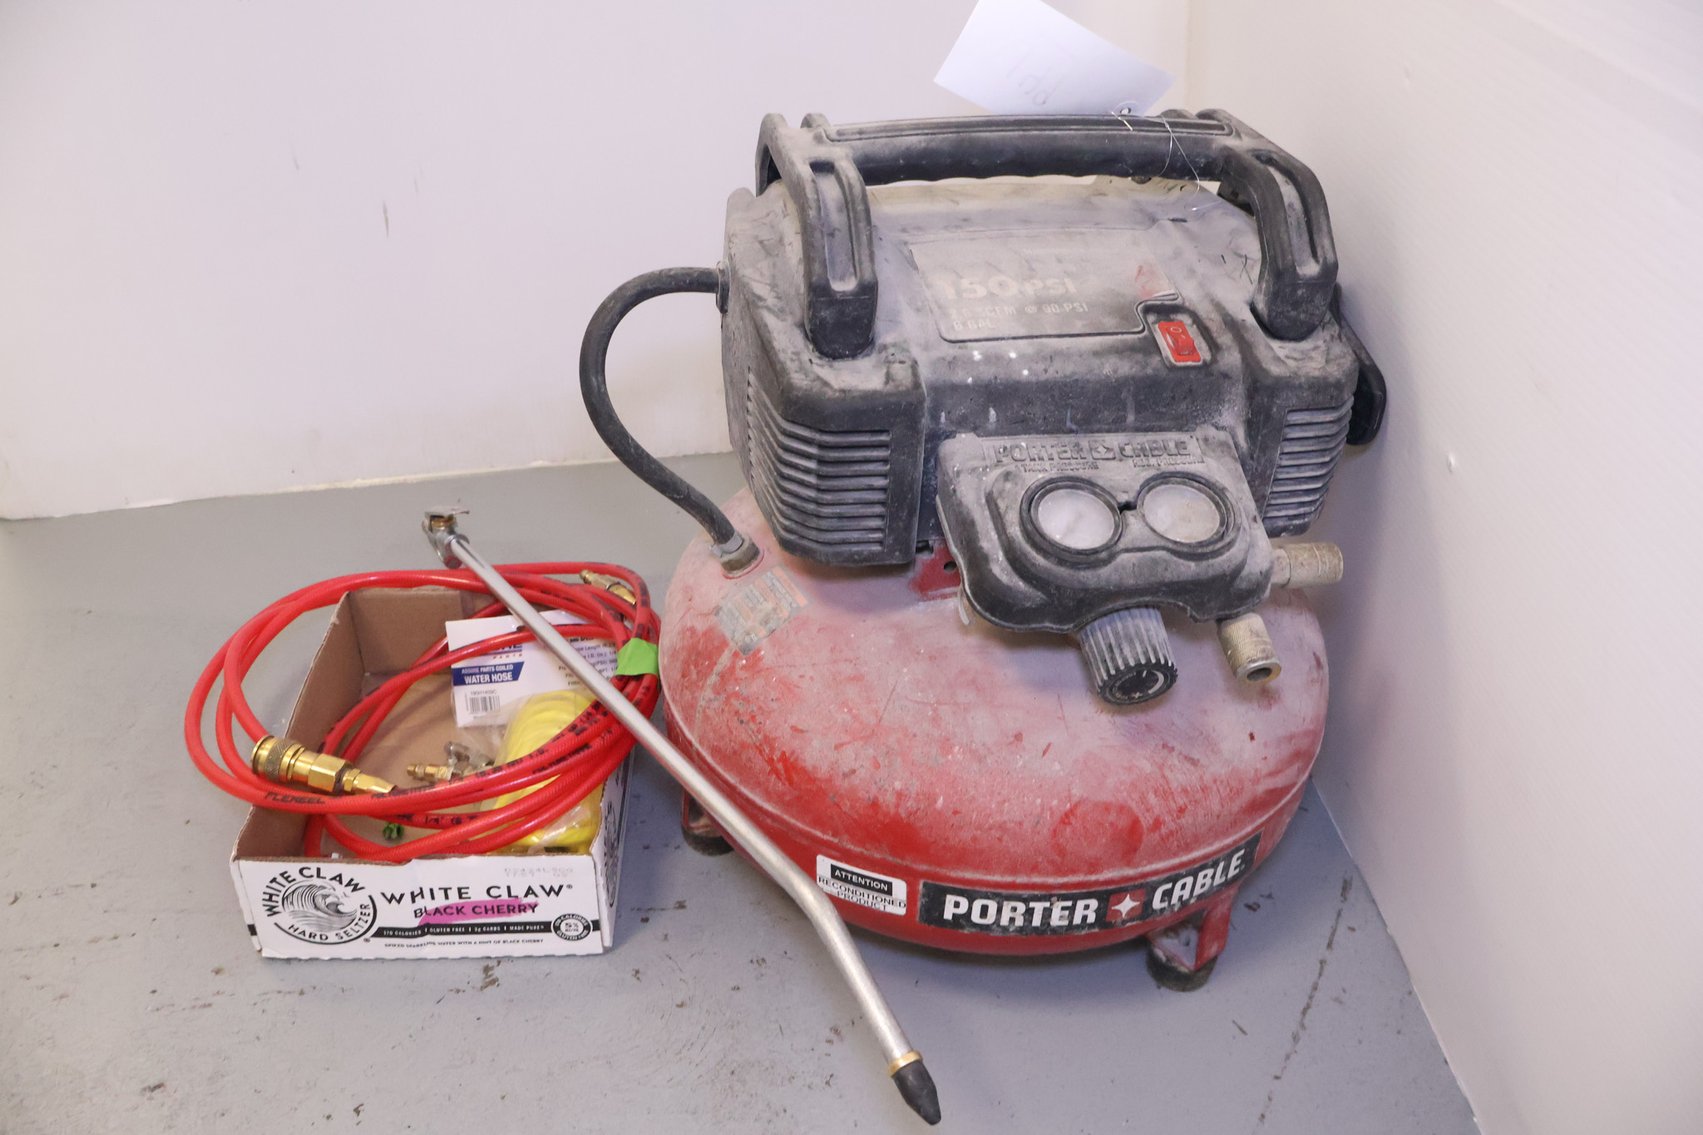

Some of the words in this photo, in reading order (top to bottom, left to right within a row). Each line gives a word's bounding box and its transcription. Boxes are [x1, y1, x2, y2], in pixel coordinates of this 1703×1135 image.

[464, 673, 490, 686] WATER
[491, 671, 513, 683] HOSE
[262, 870, 297, 917] WHITE
[298, 866, 366, 893] CLAW
[818, 875, 907, 909] RECONDITIONED
[834, 868, 889, 892] ATTENTION
[943, 893, 1099, 928] PORTER
[1151, 848, 1246, 912] CABLE
[380, 886, 472, 905] WHITE
[837, 889, 888, 912] PRODUCT
[287, 923, 329, 941] HARD
[335, 902, 372, 940] SELTZER
[413, 904, 466, 920] BLACK
[471, 902, 539, 915] CHERRY
